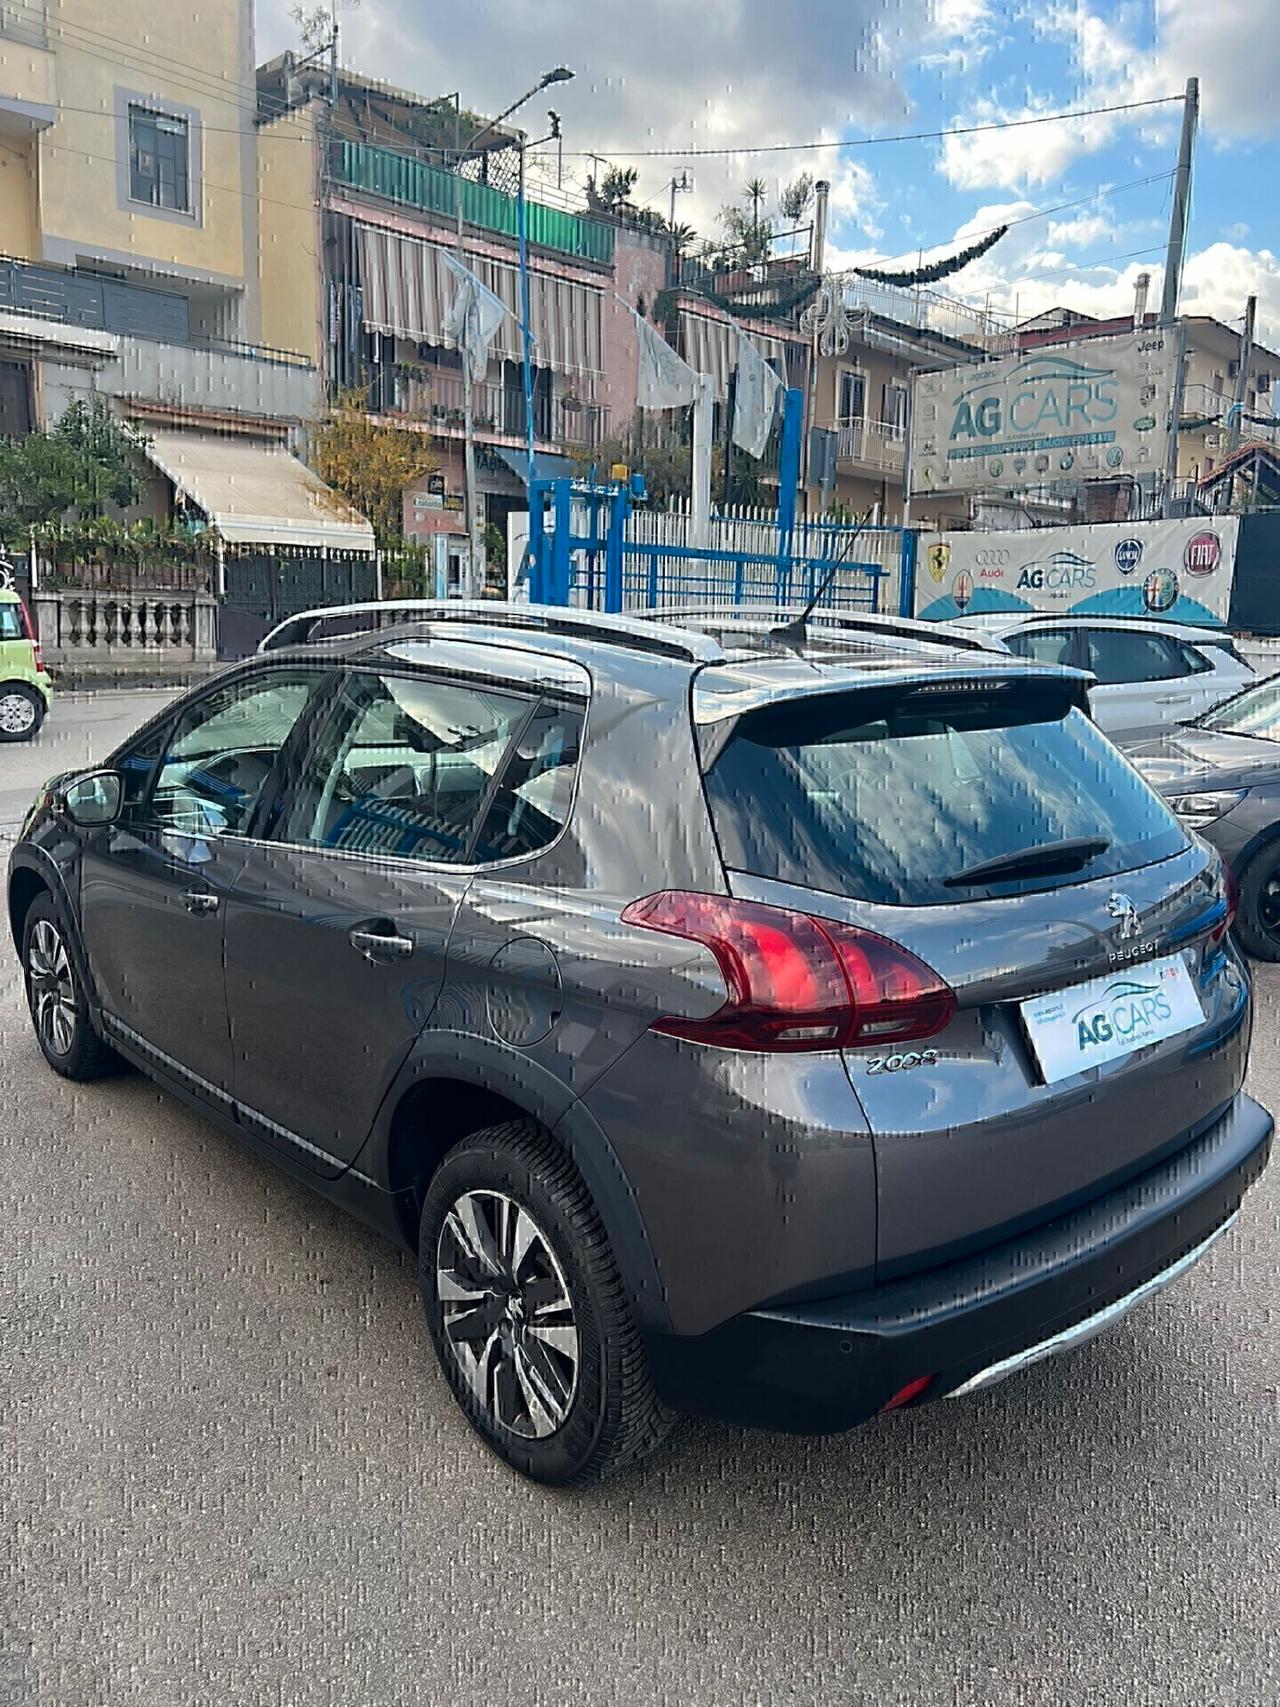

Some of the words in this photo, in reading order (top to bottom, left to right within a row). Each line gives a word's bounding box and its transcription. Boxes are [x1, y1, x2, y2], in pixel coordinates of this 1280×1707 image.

[1138, 339, 1164, 352] Jeep
[949, 397, 1001, 440] AG
[1009, 379, 1120, 432] CARS
[1190, 544, 1215, 566] FIAT
[979, 568, 1004, 578] Audi
[1016, 569, 1043, 589] AG
[1046, 568, 1097, 589] CARS
[1108, 939, 1160, 963] PEUGEOT
[1077, 1014, 1113, 1050] AG
[1113, 993, 1172, 1035] CARS
[866, 1049, 938, 1075] 2008
